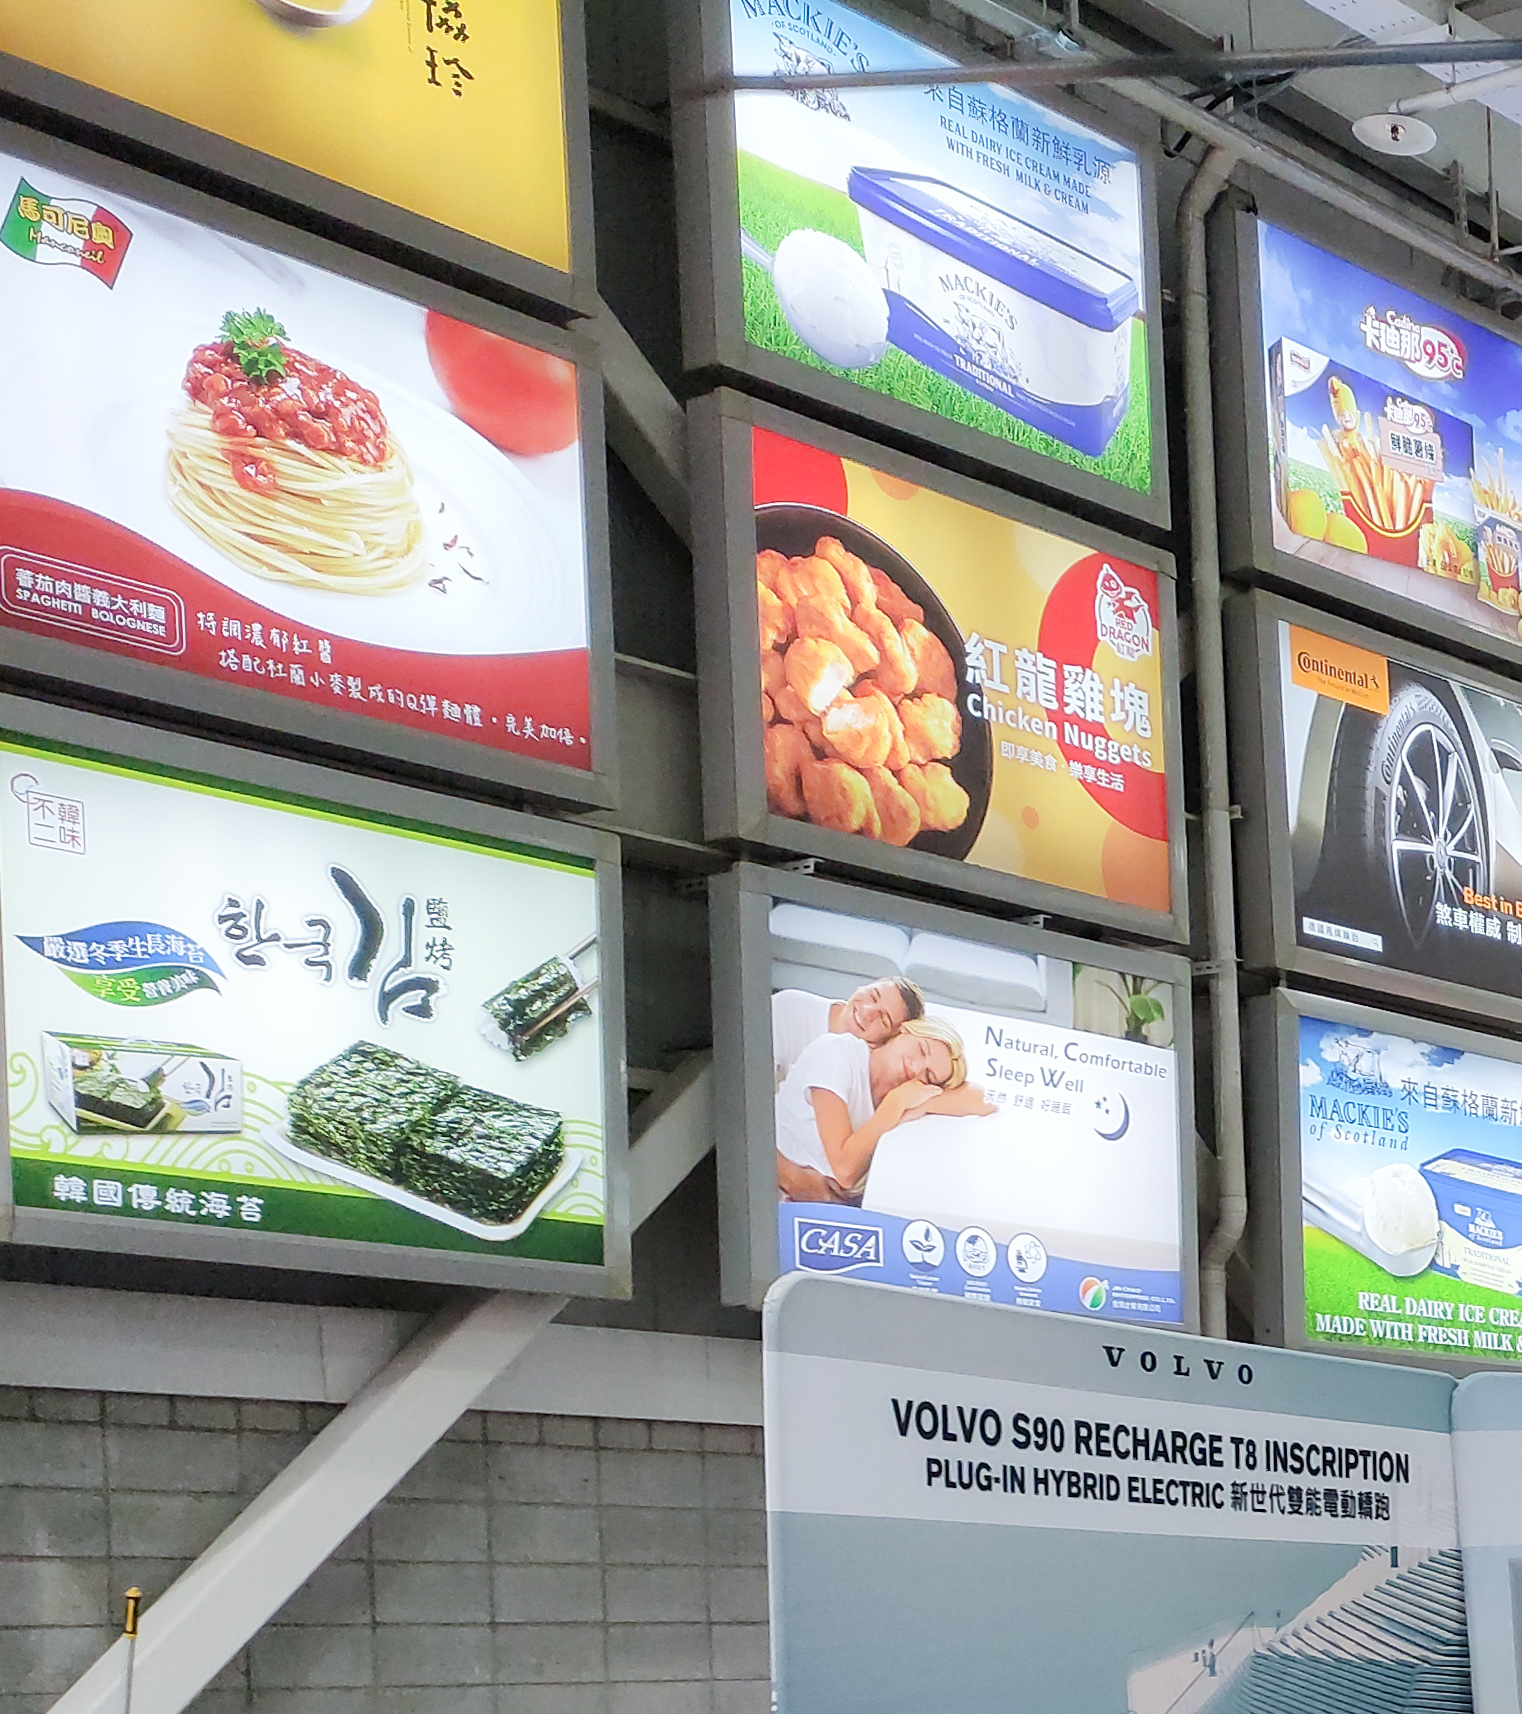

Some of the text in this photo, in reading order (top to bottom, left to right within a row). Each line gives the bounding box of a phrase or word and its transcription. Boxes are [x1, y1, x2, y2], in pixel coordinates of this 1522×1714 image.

[939, 115, 1093, 199] REAL DAIRY ICE CREAM MADE
[946, 137, 1090, 216] WITH FRESH MILK & CREAM
[938, 274, 1018, 331] MACKIE'S
[1360, 315, 1421, 363] 卡迪那
[952, 353, 1016, 398] TRADITIONAL
[15, 587, 167, 638] SPAGHETTI BOLOGNESE
[1115, 618, 1134, 634] RED
[1101, 625, 1150, 652] DRAGON
[964, 632, 1153, 739] 紅龍雞塊
[1297, 651, 1368, 689] Continental
[967, 692, 1153, 769] Chicken Nuggets
[1381, 702, 1413, 786] Continental
[32, 796, 56, 845] 不二
[1434, 901, 1502, 941] 煞車權威
[1464, 885, 1498, 912] Best
[1499, 896, 1513, 916] in
[43, 932, 205, 965] 嚴選冬季生長海苔
[984, 1024, 1169, 1081] Natural, Comfortable
[985, 1057, 1085, 1094] Sleep Well
[1309, 1094, 1410, 1135] MACKIE'S
[1309, 1121, 1410, 1152] of Scotland
[52, 1172, 265, 1223] 韓國傳統海苔
[799, 1227, 879, 1261] CASA
[1358, 1291, 1402, 1314] REAL
[1405, 1296, 1455, 1321] DAIRY
[1458, 1303, 1486, 1324] ICE
[1315, 1312, 1366, 1337] MADE
[1369, 1318, 1415, 1343] WITH
[1417, 1322, 1469, 1348] FRESH
[1473, 1330, 1513, 1353] MILK
[1102, 1344, 1255, 1386] VOLVO
[890, 1397, 1411, 1484] VOLVO S90 RECHARGE T8 INSCRIPTION
[925, 1456, 1391, 1522] PLUG-IN HYBRID ELECTRIC 新世代雙能電動轎跑
